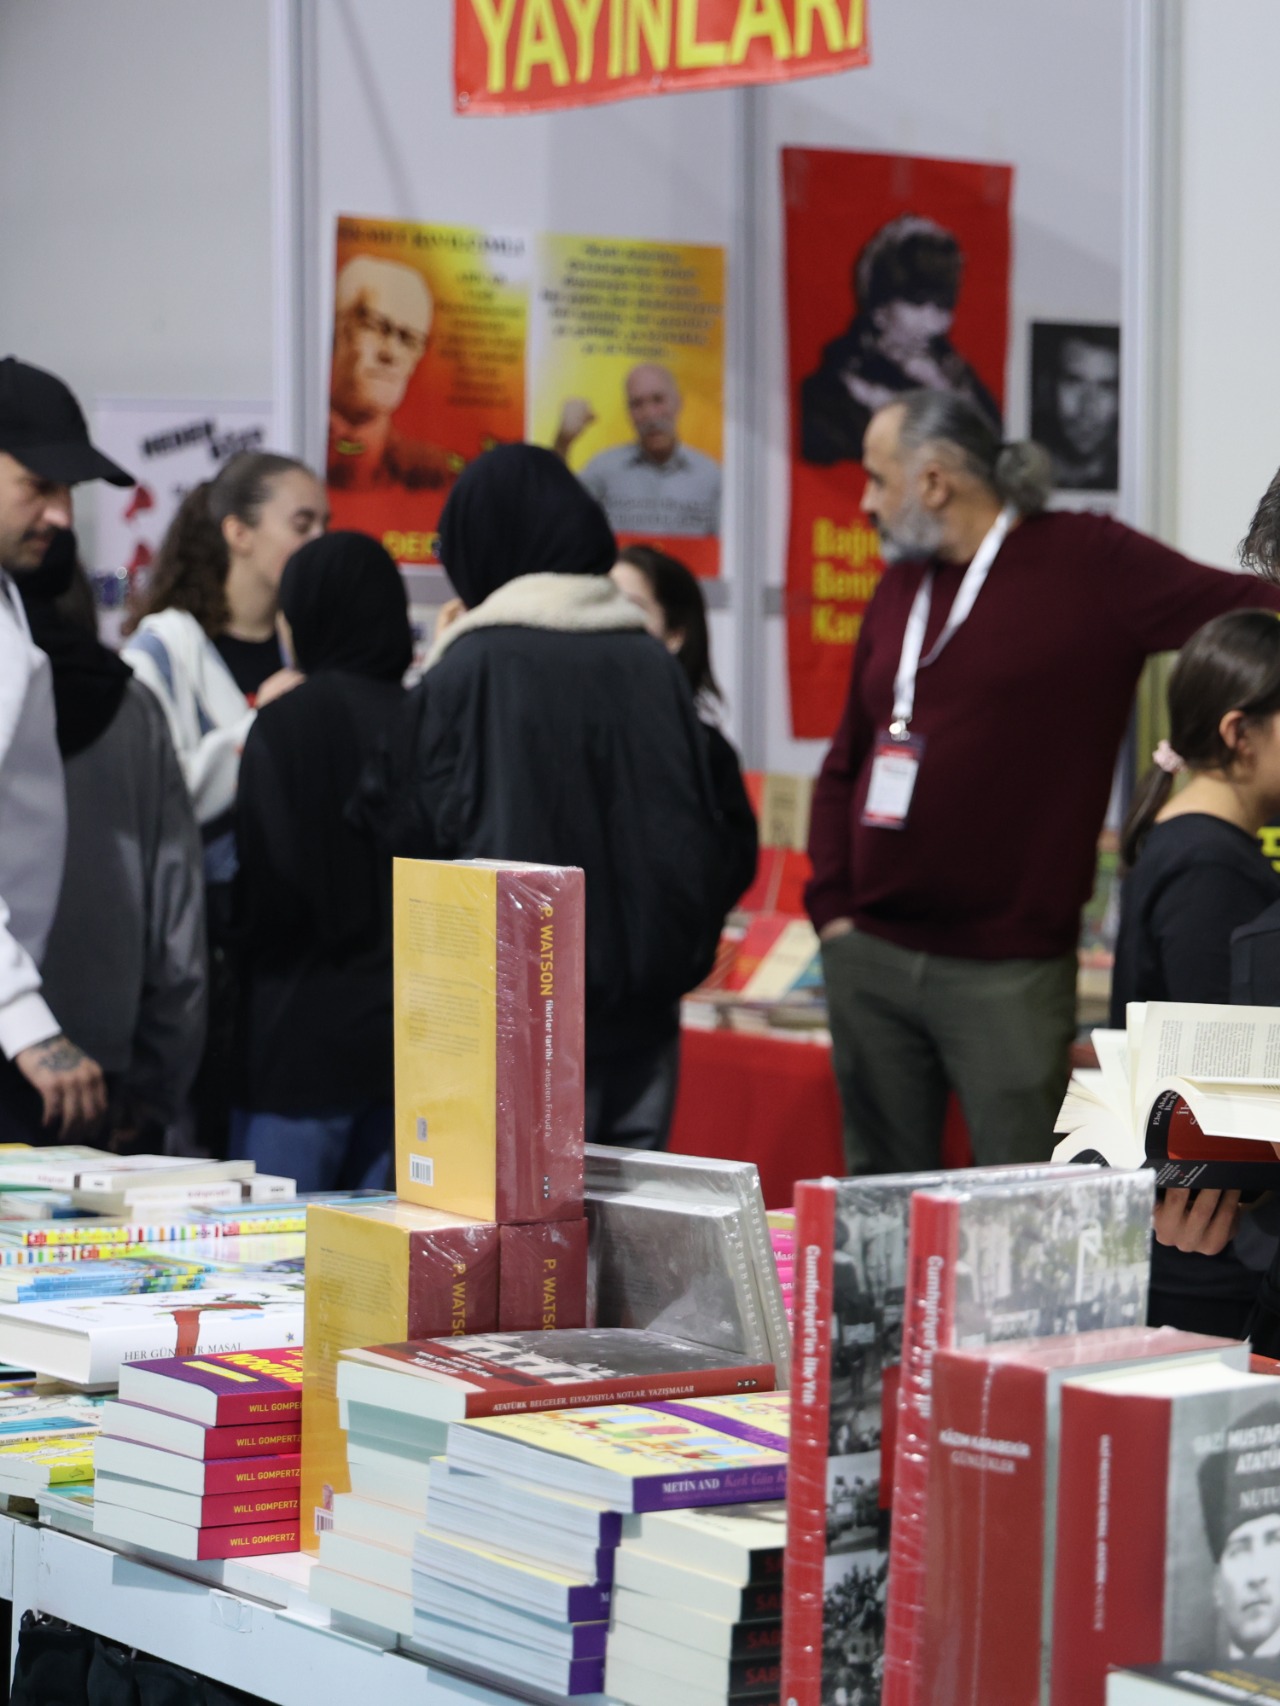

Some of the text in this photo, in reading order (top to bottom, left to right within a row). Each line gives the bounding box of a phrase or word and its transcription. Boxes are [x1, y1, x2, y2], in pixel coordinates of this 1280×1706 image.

[467, 0, 867, 94] YAYINLARI
[540, 924, 553, 996] WATSON
[545, 1000, 553, 1031] fikirler
[545, 1036, 553, 1060] tarihi
[453, 1263, 466, 1277] P.
[543, 1259, 557, 1273] P.
[124, 1349, 147, 1361] HER
[207, 1342, 242, 1354] MASAL
[492, 1401, 528, 1413] ATATÜRK
[649, 1385, 695, 1397] YAZIŞMALAR
[249, 1402, 301, 1413] WILL GOMPE
[236, 1434, 301, 1447] WILL GOMPERTZ
[236, 1469, 301, 1482] WILL GOMPERTZ
[662, 1478, 696, 1493] METİN
[698, 1478, 720, 1490] AND
[233, 1500, 298, 1514] WILL GOMPERTZ
[230, 1533, 296, 1547] WILL GOMPERTZ
